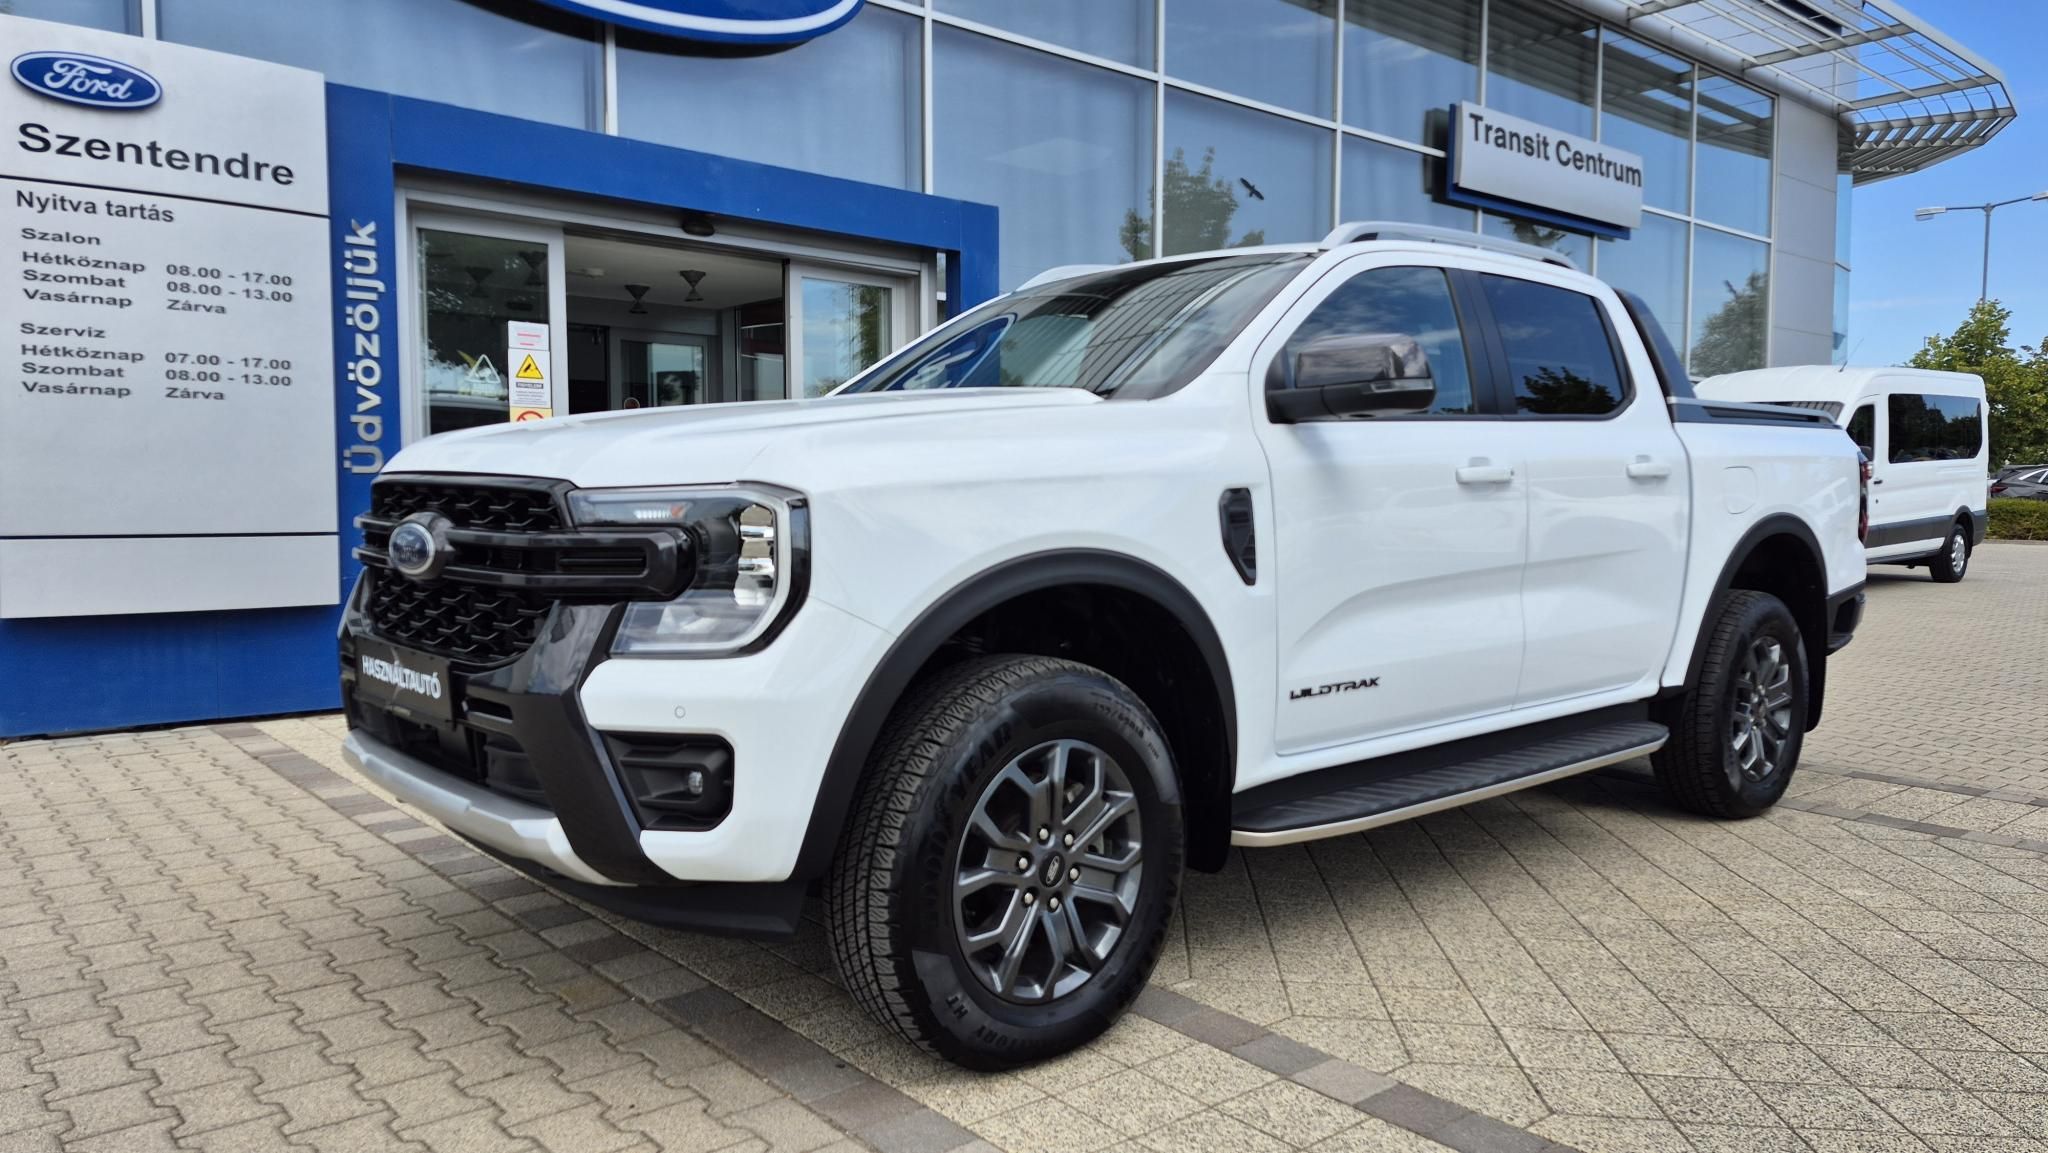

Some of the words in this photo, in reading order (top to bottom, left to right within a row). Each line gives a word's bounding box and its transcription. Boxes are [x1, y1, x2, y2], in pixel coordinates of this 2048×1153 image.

[44, 59, 133, 100] Ford
[18, 123, 294, 186] Szentendre
[1469, 113, 1550, 161] Transit
[1555, 140, 1643, 187] Centrum
[16, 190, 97, 214] Nyitva
[105, 200, 175, 222] tartás
[21, 227, 101, 246] Szalon
[22, 251, 146, 274] Hétköznap
[166, 263, 222, 280] 08.00
[242, 271, 293, 287] 17.00
[23, 269, 126, 288] Szombat
[166, 281, 222, 296] 08.00
[242, 288, 293, 303] 13.00
[23, 288, 133, 308] Vasárnap
[166, 298, 227, 315] Zárva
[20, 322, 106, 339] Szerviz
[344, 218, 386, 474] Üdvözöljük
[21, 344, 145, 363] Hétköznap
[165, 352, 221, 366] 07.00
[240, 357, 292, 371] 17.00
[21, 362, 125, 378] Szombat
[165, 369, 221, 383] 08.00
[240, 373, 292, 387] 13.00
[21, 381, 131, 399] Vasárnap
[165, 386, 225, 401] Zárva
